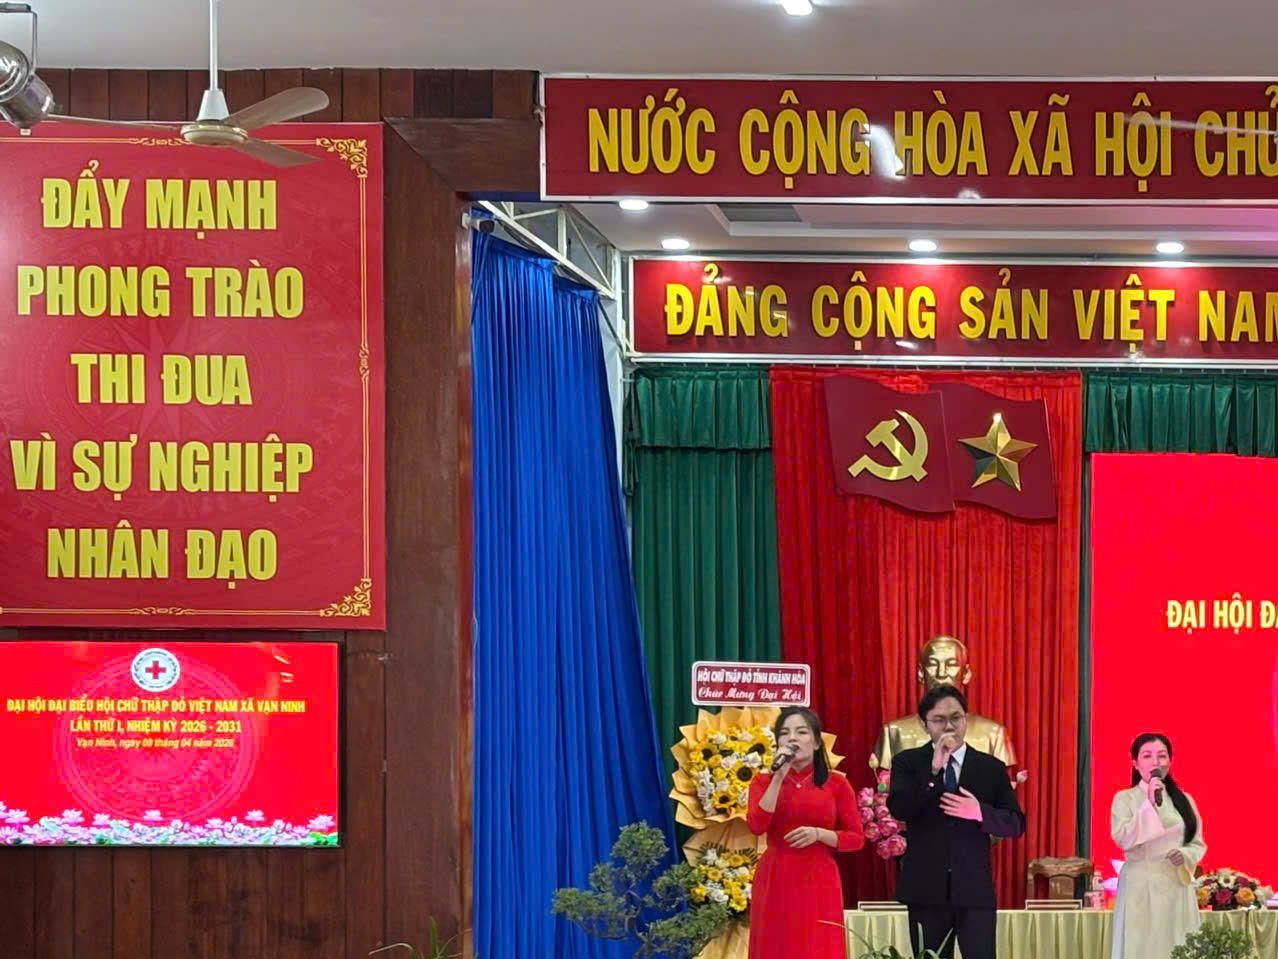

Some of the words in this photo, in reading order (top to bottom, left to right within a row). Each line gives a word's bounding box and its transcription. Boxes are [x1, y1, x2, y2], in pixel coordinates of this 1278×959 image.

[589, 88, 715, 174] NƯỚC
[740, 90, 870, 189] CỘNG
[894, 90, 988, 176] HÒA
[1009, 94, 1073, 175] XÃ
[1096, 93, 1171, 192] HỘI
[40, 160, 131, 229] ĐẨY
[146, 179, 277, 240] MẠNH
[17, 264, 171, 319] PHONG
[185, 259, 304, 318] TRÀO
[664, 261, 789, 337] ĐẢNG
[812, 271, 936, 351] CỘNG
[959, 268, 1048, 341] SẢN
[1073, 274, 1175, 349] VIỆT
[70, 353, 145, 404] THI
[160, 354, 253, 405] ĐUA
[10, 432, 56, 490] VÌ
[73, 434, 138, 501] SỰ
[149, 434, 313, 502] NGHIỆP
[48, 520, 169, 578] NHÂN
[185, 529, 277, 589] ĐẠO
[1167, 600, 1205, 634] ĐẠI
[1214, 592, 1252, 634] HỘI
